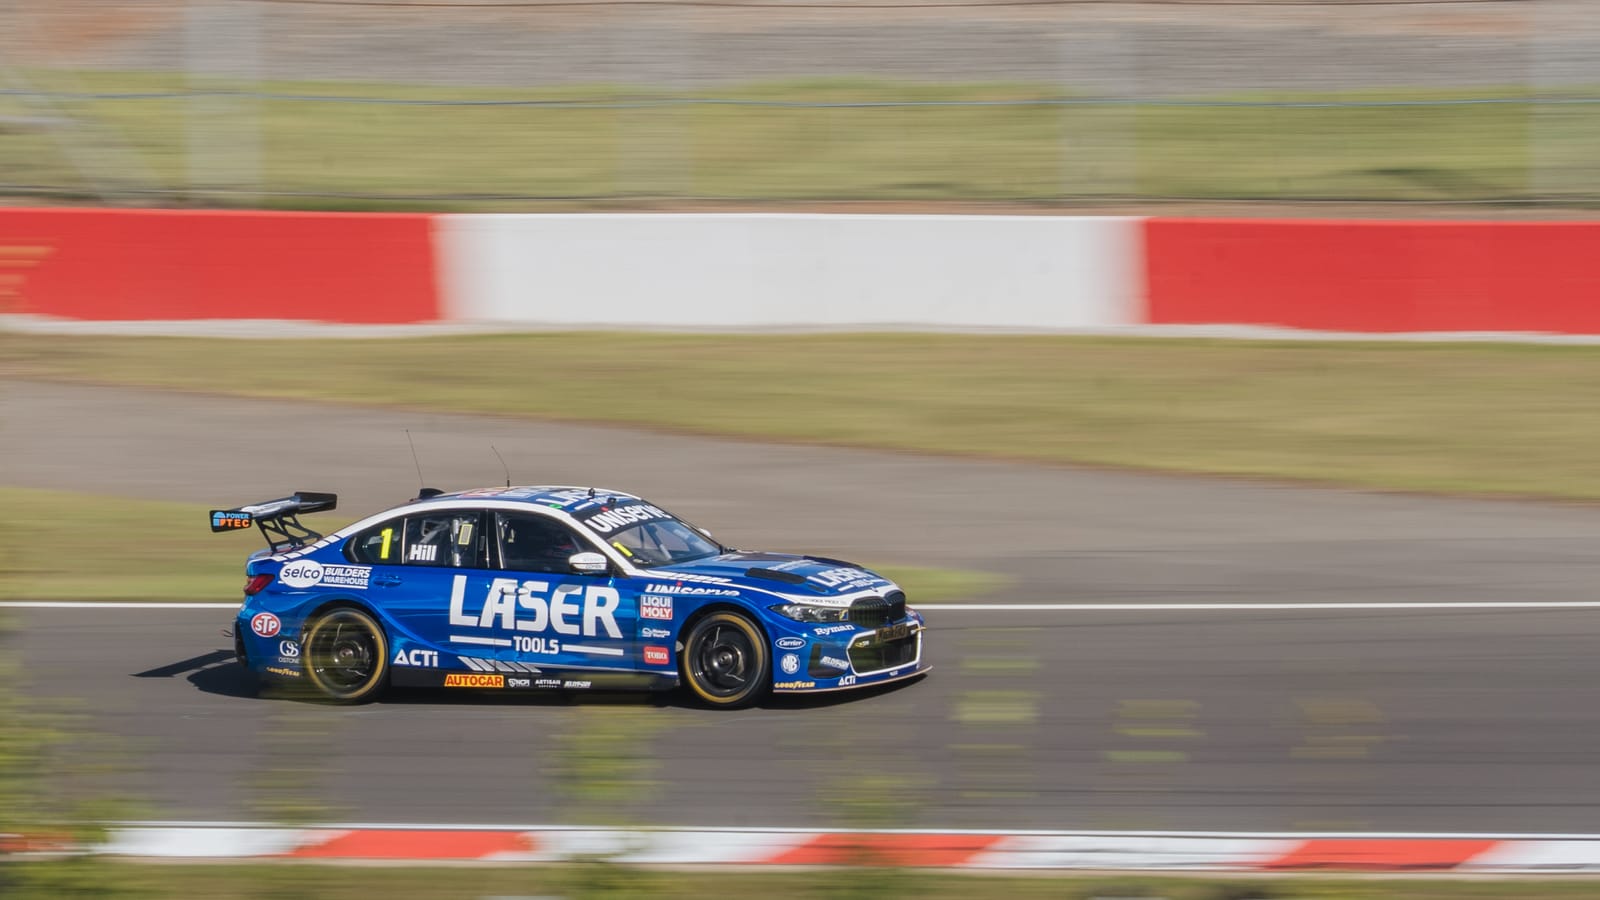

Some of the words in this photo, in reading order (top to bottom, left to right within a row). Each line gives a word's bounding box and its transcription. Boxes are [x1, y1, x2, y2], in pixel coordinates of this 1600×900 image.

[381, 528, 393, 559] 1
[612, 541, 633, 557] 1
[409, 544, 437, 561] Hill
[283, 566, 320, 579] selco
[325, 567, 370, 578] BUILDERS
[324, 576, 369, 586] WAREHOUSE
[449, 575, 624, 639] LASER
[642, 596, 671, 607] LIQUI
[642, 607, 672, 618] MOLY
[255, 615, 277, 634] STP
[813, 625, 855, 636] Ryman
[513, 636, 559, 654] TOOLS
[779, 640, 803, 648] Carrier
[446, 674, 503, 687] AUTOCAR
[775, 681, 816, 689] GOODYEAR
